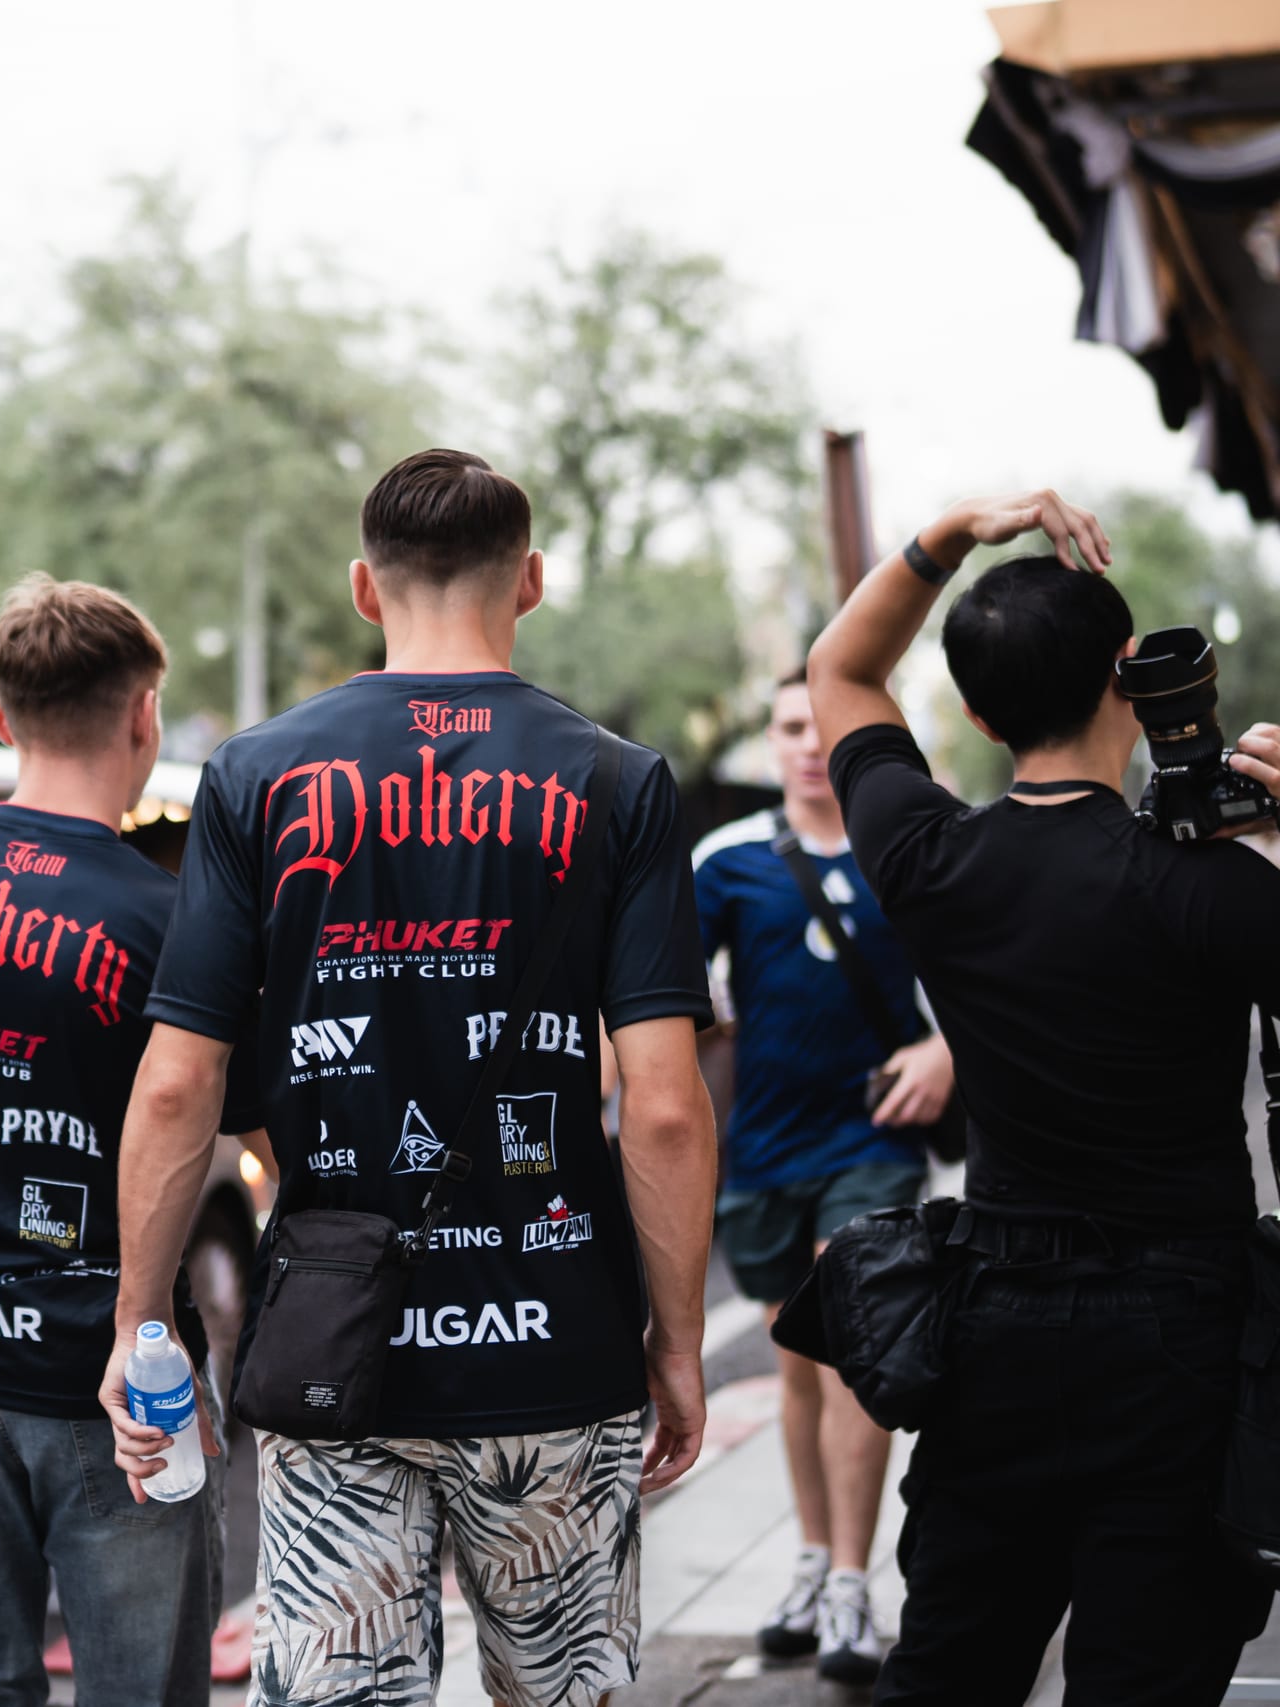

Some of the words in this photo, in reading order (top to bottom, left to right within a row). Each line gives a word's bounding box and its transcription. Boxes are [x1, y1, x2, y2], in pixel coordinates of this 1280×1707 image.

[408, 699, 492, 740] Team
[264, 744, 589, 909] Doherty
[317, 919, 513, 957] PHUKET
[404, 954, 437, 963] MADE
[441, 954, 465, 962] NOT
[467, 953, 496, 961] BORN
[317, 965, 404, 983] FIGHT
[419, 963, 496, 978] CLUB
[350, 1064, 376, 1075] WIN.
[497, 1103, 518, 1124] GL
[499, 1124, 528, 1144] DRY
[22, 1184, 44, 1203] GL
[21, 1202, 52, 1220] DRY
[389, 1300, 552, 1348] ULGAR
